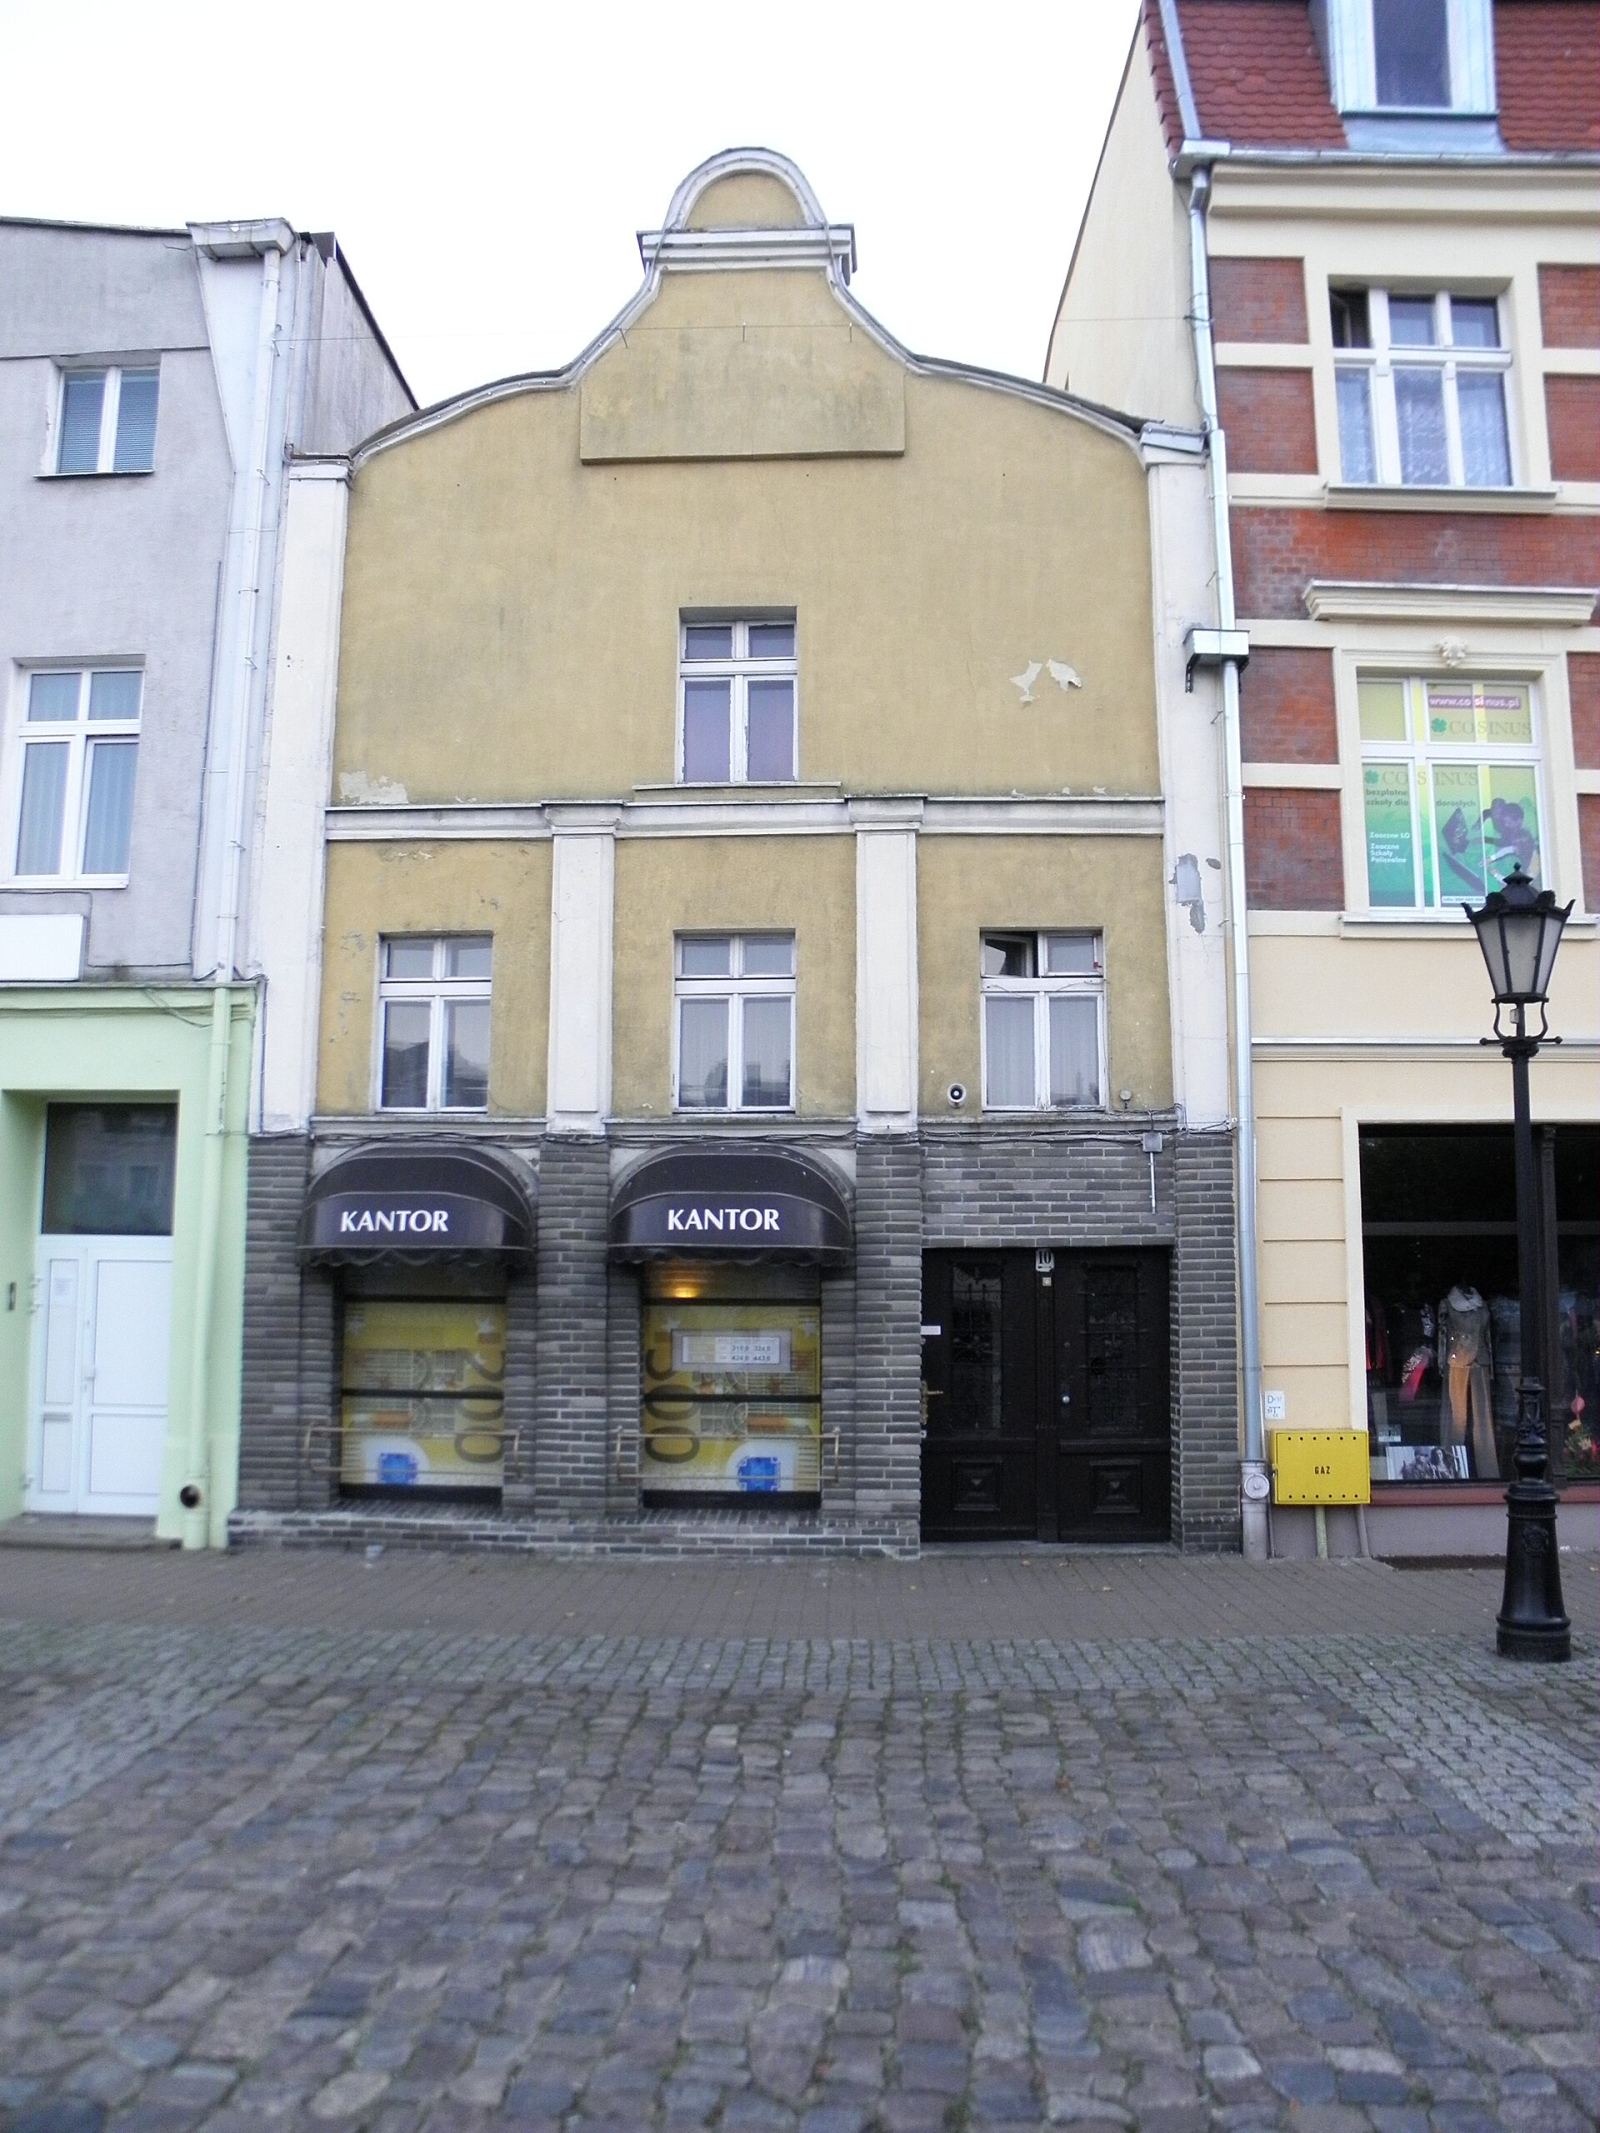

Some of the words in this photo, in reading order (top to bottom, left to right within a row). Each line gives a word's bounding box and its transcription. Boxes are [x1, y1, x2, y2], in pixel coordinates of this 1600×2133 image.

[1449, 720, 1532, 736] COSINUS
[1382, 771, 1478, 786] COSINUS
[340, 1210, 449, 1232] KANTOR
[667, 1208, 780, 1231] KANTOR
[1038, 1250, 1052, 1264] 10
[1314, 1466, 1331, 1475] GAZ
